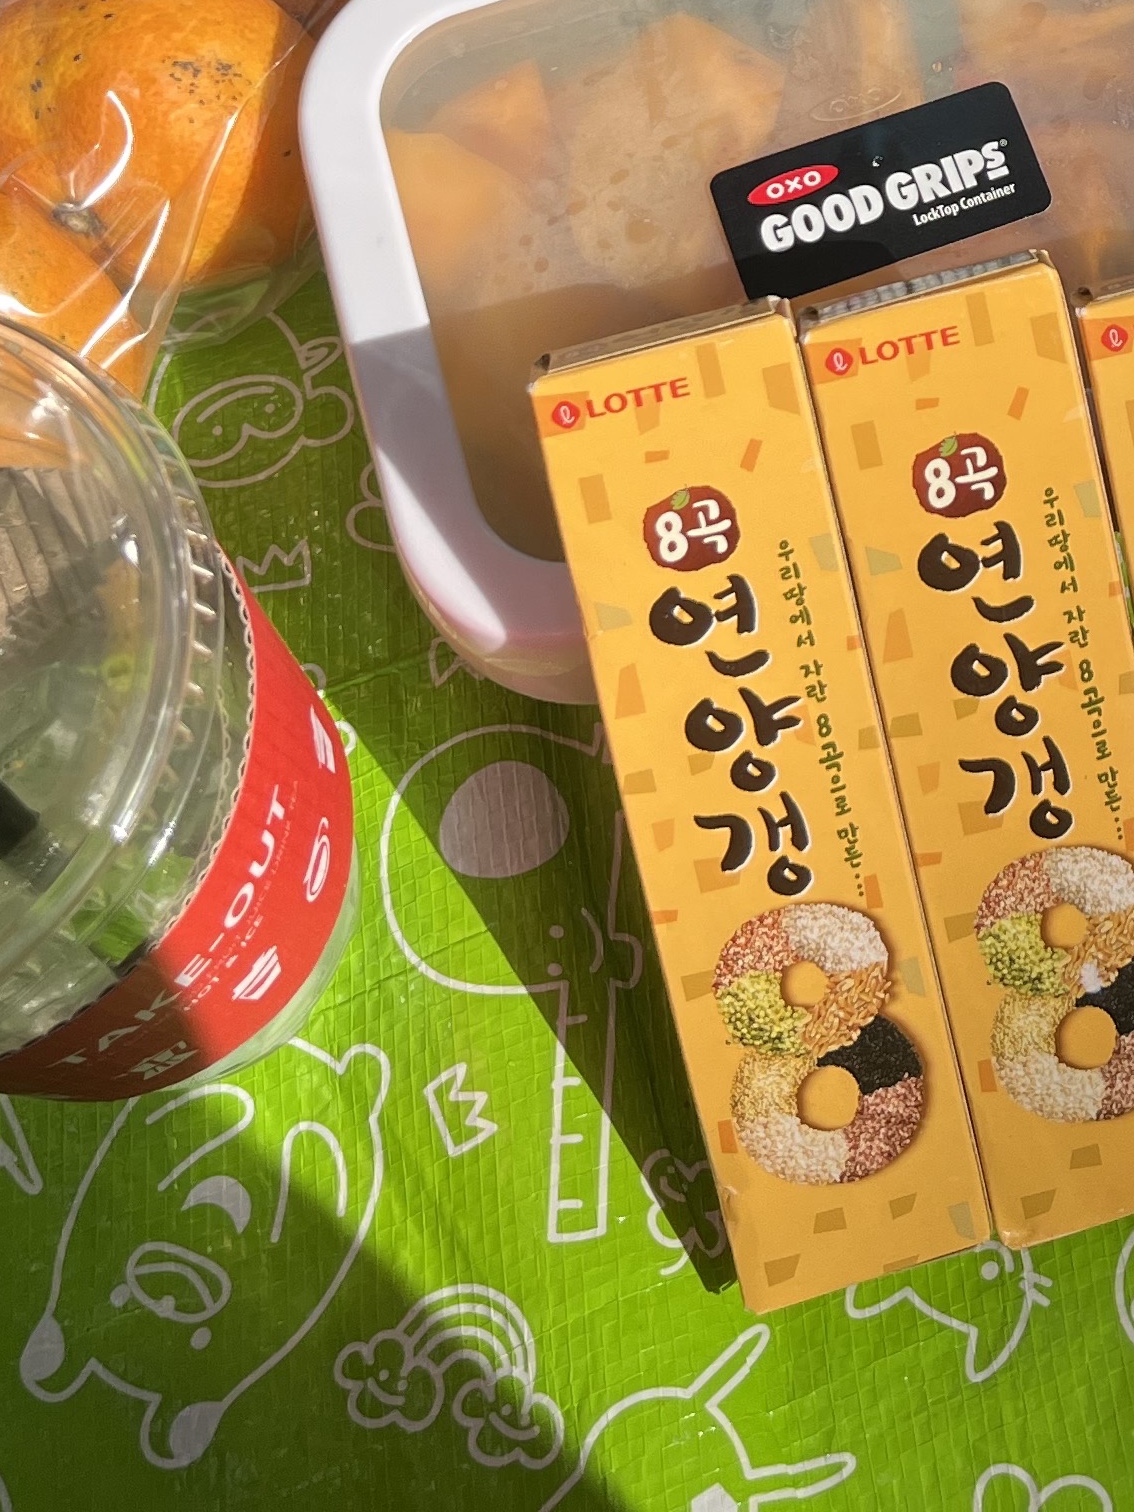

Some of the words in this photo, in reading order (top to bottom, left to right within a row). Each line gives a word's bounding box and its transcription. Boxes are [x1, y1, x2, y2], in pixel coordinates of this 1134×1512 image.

[759, 184, 885, 253] GOOD
[765, 169, 822, 199] OXO
[912, 194, 960, 227] LockTop
[960, 181, 1017, 210] Container
[858, 325, 961, 366] LOTTE
[585, 376, 691, 418] LOTTE
[924, 445, 999, 509] 8곡
[654, 498, 733, 563] 8곡
[1043, 486, 1080, 595] 우리땅에서
[1063, 604, 1090, 649] 자란
[1078, 658, 1113, 761] 8곡으로
[777, 539, 816, 649] 우리땅에서
[800, 659, 828, 703] 자란
[816, 713, 853, 817] 8곡으로
[916, 520, 1075, 841] 연양갱
[648, 573, 811, 897] 연양갱
[46, 784, 286, 1069] TAKE-OUT
[183, 976, 221, 1013] HOT
[240, 915, 265, 949] ICE
